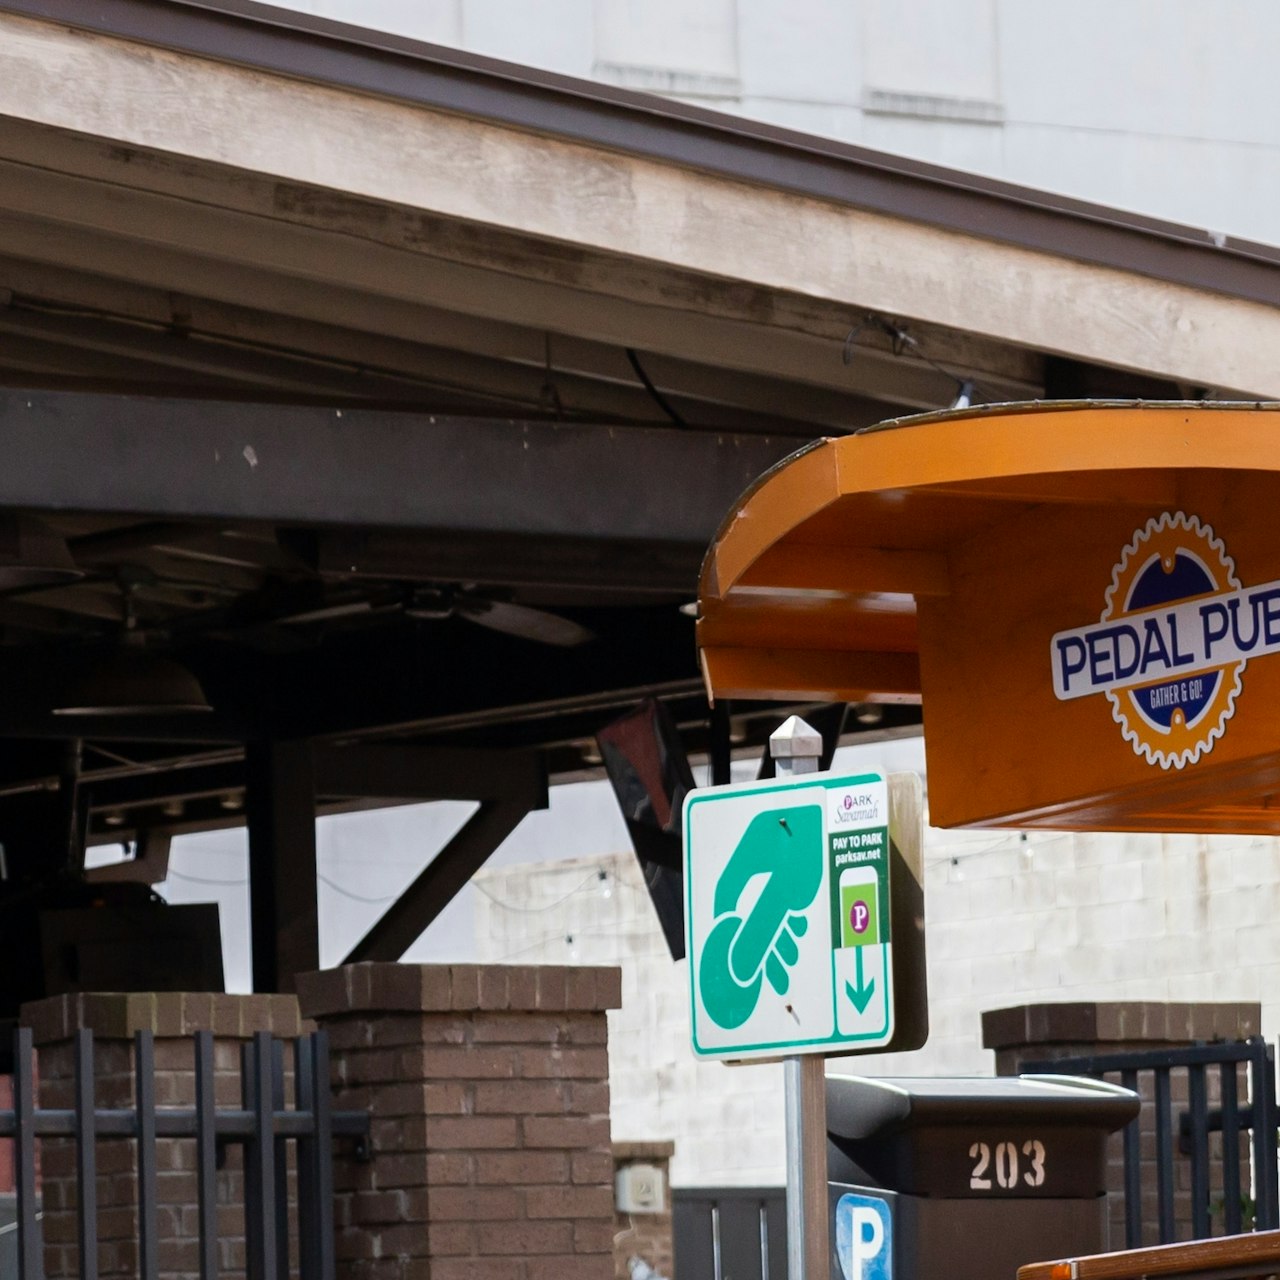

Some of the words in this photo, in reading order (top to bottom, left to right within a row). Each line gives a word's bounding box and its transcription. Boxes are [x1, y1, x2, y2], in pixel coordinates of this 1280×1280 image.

[1057, 613, 1195, 692] PEDAL
[1150, 684, 1180, 709] GATHER
[1181, 682, 1188, 702] &
[1189, 679, 1203, 700] GO!
[835, 800, 880, 824] Savannah
[844, 795, 872, 810] PARK
[833, 837, 848, 850] PAY
[849, 835, 860, 848] TO
[861, 832, 883, 846] PARK
[835, 848, 881, 867] parksav.net
[854, 905, 867, 929] P
[969, 1140, 1046, 1190] 203
